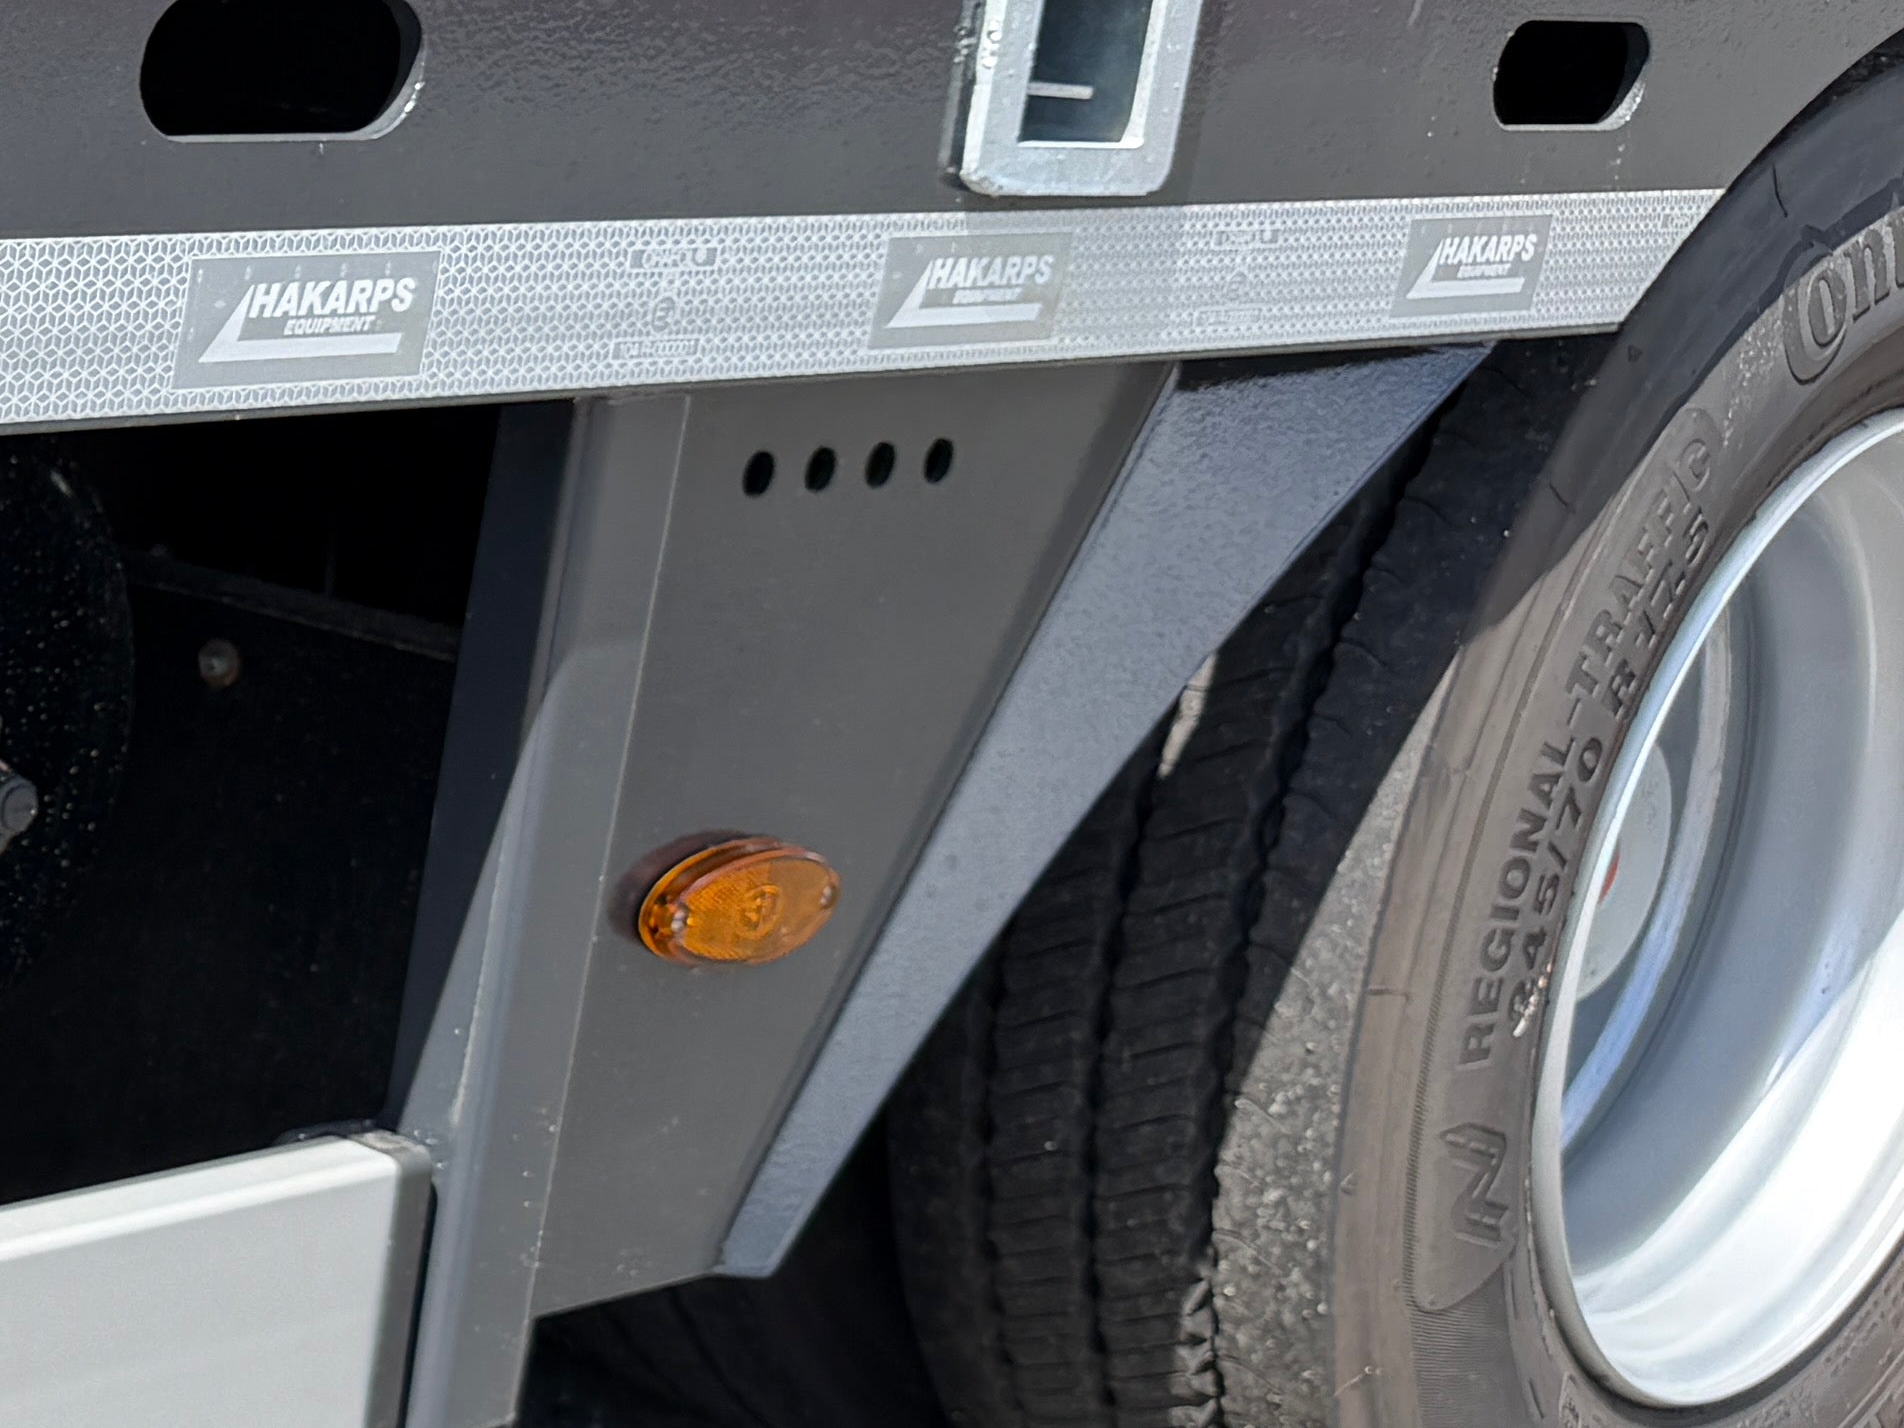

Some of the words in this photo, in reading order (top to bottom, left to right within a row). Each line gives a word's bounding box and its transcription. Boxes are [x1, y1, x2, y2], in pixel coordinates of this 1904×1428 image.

[1438, 233, 1538, 265] HAKARPS
[927, 254, 1055, 289] HAKARPS
[248, 277, 416, 318] HAKARPS
[283, 315, 376, 336] EQUIPMENT
